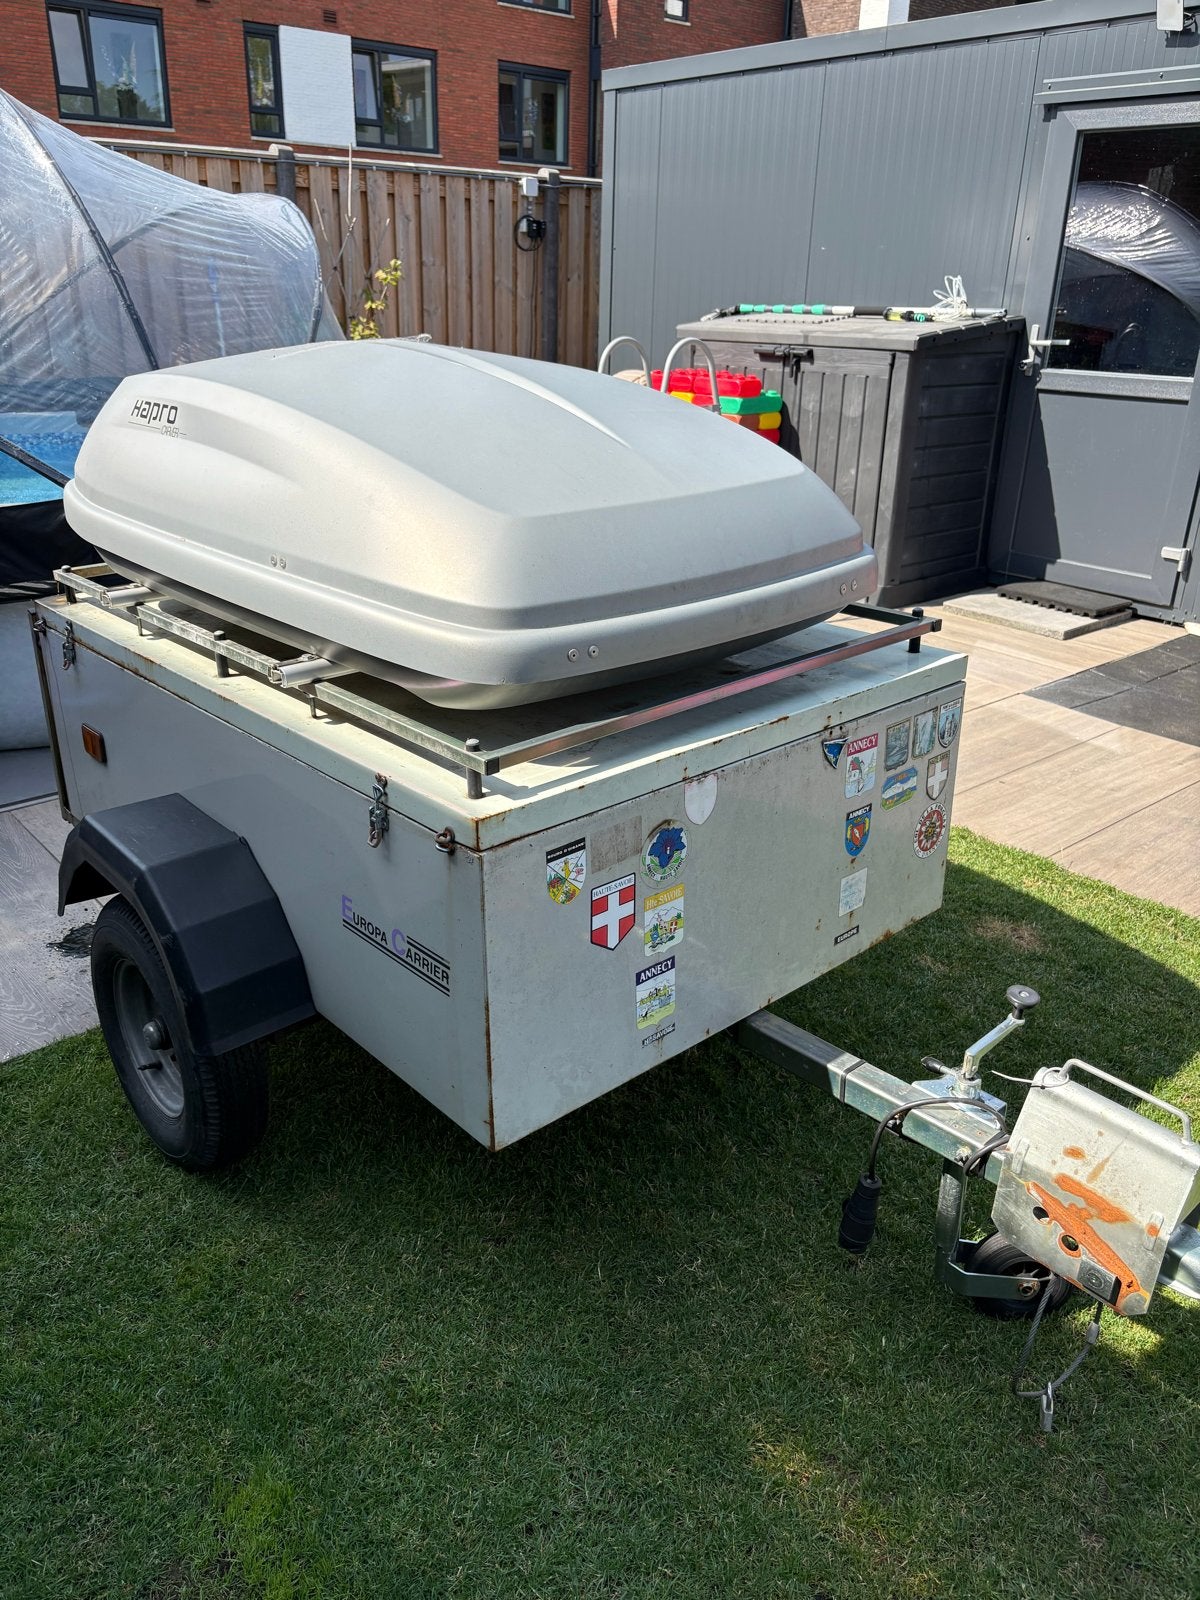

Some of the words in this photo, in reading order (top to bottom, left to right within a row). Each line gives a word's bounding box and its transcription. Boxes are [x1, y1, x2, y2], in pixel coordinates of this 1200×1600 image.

[130, 399, 179, 425] Hapro
[848, 735, 877, 754] ANNECY
[848, 806, 871, 820] ANNECY
[659, 887, 683, 905] SAVOIE
[341, 894, 388, 945] EUROPA
[391, 928, 450, 985] CARRIER
[837, 927, 858, 943] EUROPE
[639, 958, 673, 983] ANNECY
